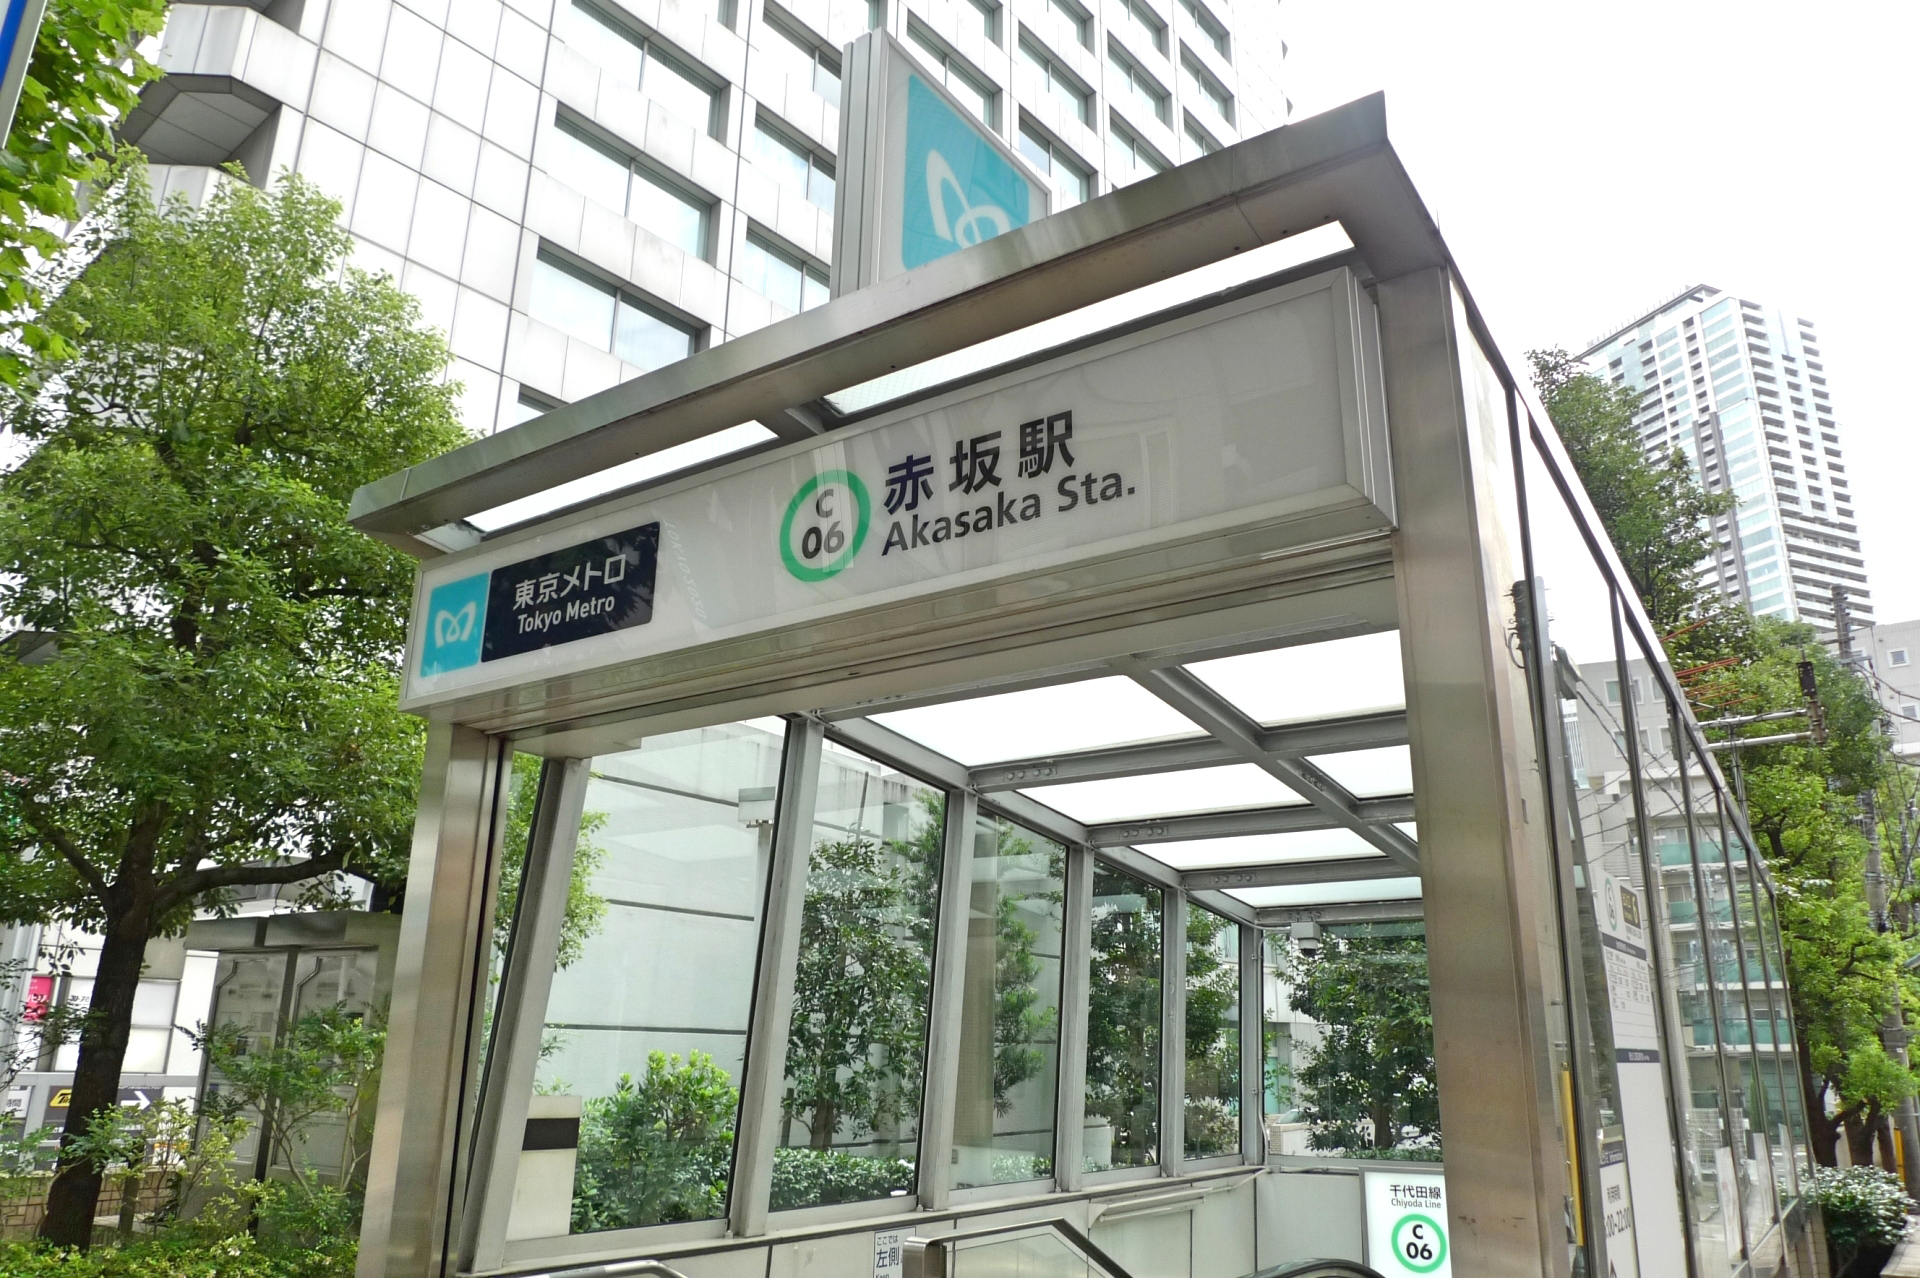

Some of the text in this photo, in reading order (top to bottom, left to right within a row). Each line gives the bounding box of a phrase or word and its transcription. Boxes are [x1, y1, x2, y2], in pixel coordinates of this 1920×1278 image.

[883, 409, 1075, 516] 赤坂駅
[815, 488, 835, 519] C
[881, 470, 1136, 557] Akasaka Sta.
[801, 520, 846, 560] 06
[512, 554, 627, 611] 東京メトロ
[517, 595, 616, 634] Tokyo Metro
[1389, 1184, 1442, 1199] 千代田線
[1391, 1198, 1441, 1208] Chiyoda Line
[877, 1234, 898, 1246] ここでは
[1412, 1223, 1424, 1240] C
[876, 1246, 902, 1268] 左側
[1406, 1241, 1433, 1260] 06
